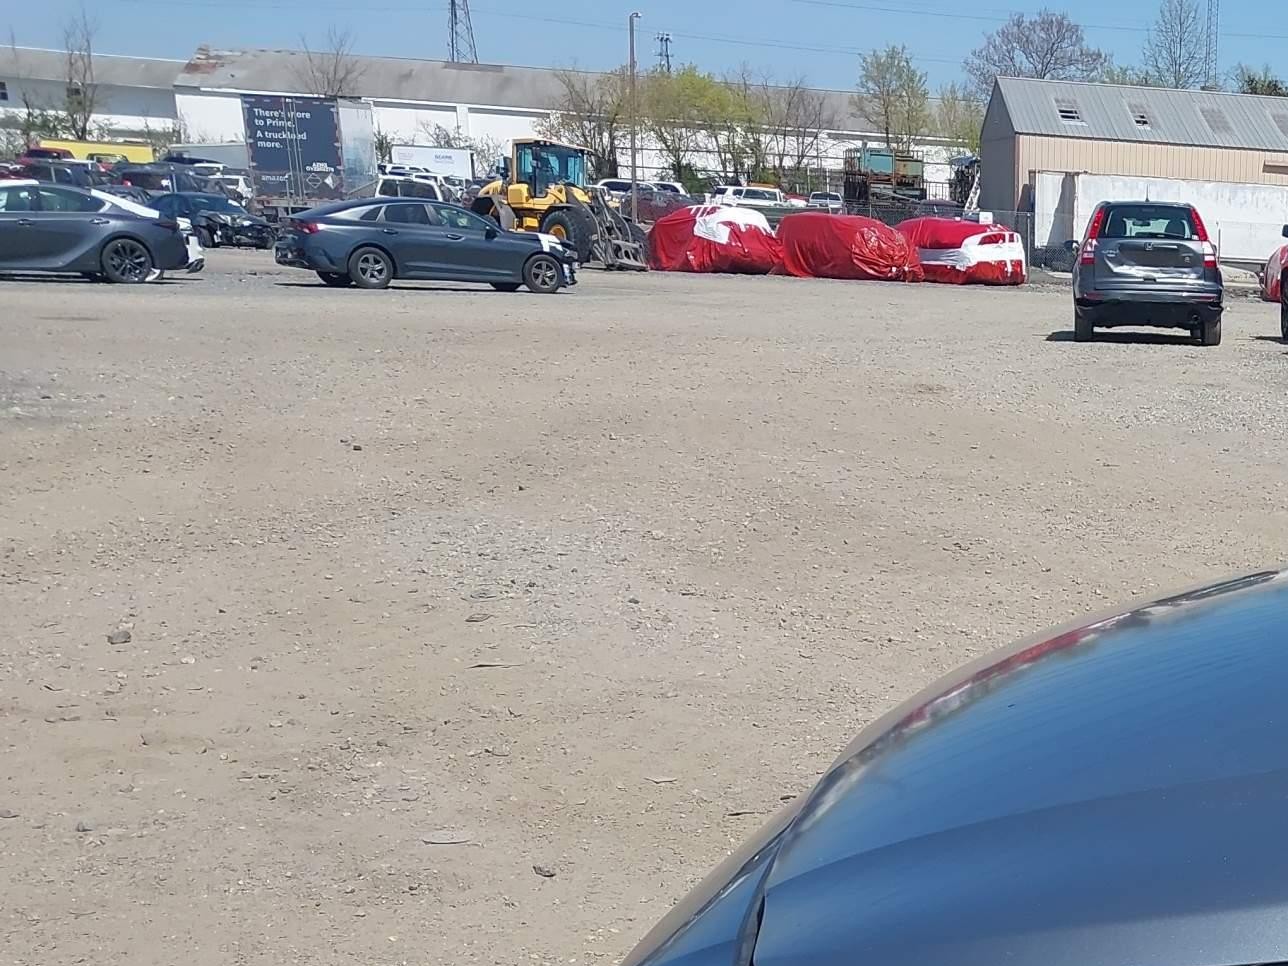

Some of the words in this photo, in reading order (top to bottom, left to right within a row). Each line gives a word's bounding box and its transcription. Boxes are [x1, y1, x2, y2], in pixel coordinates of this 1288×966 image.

[253, 108, 285, 118] There's
[254, 118, 265, 127] to
[266, 118, 296, 128] Prime.
[256, 130, 264, 139] A
[264, 131, 307, 140] truckload
[257, 141, 283, 149] more.
